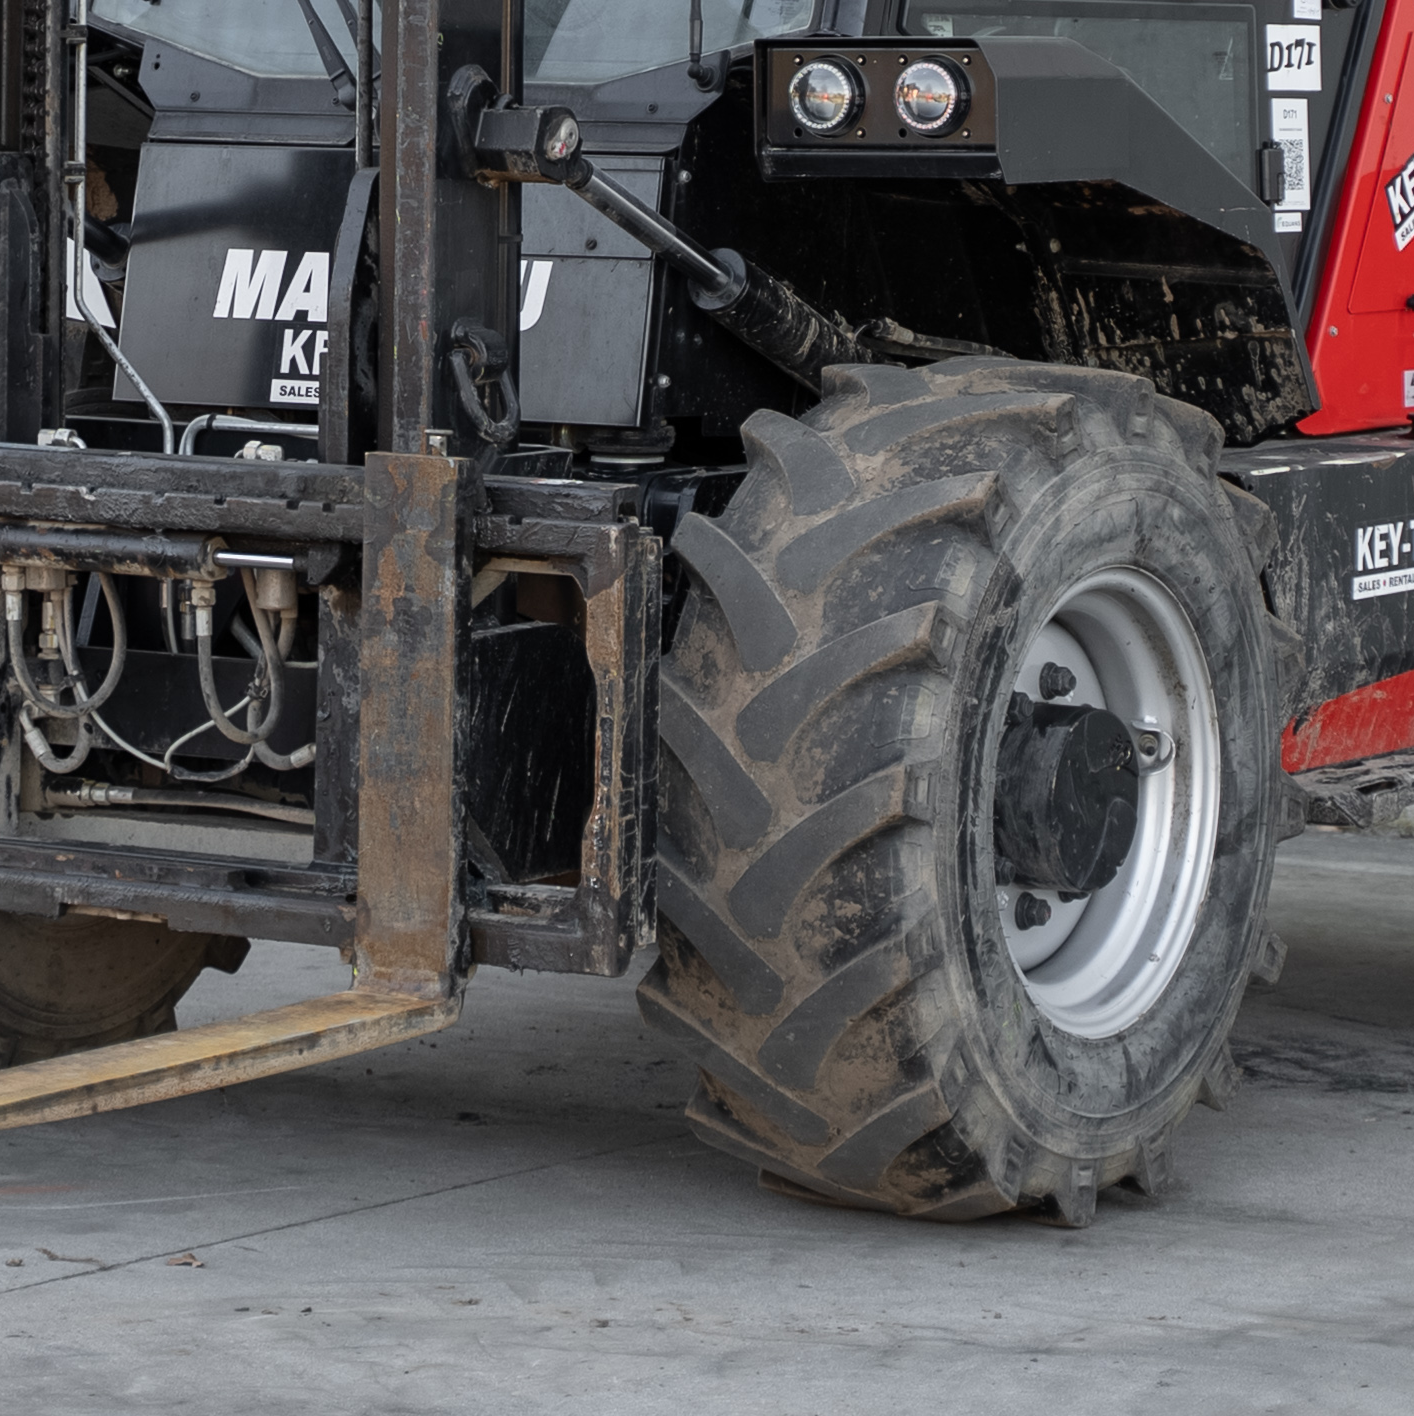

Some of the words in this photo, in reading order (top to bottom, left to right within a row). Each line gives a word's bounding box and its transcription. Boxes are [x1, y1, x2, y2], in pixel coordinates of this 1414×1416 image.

[1267, 39, 1316, 72] D171
[1283, 109, 1298, 119] D171
[279, 385, 321, 398] SALES
[1357, 579, 1382, 594] SALES
